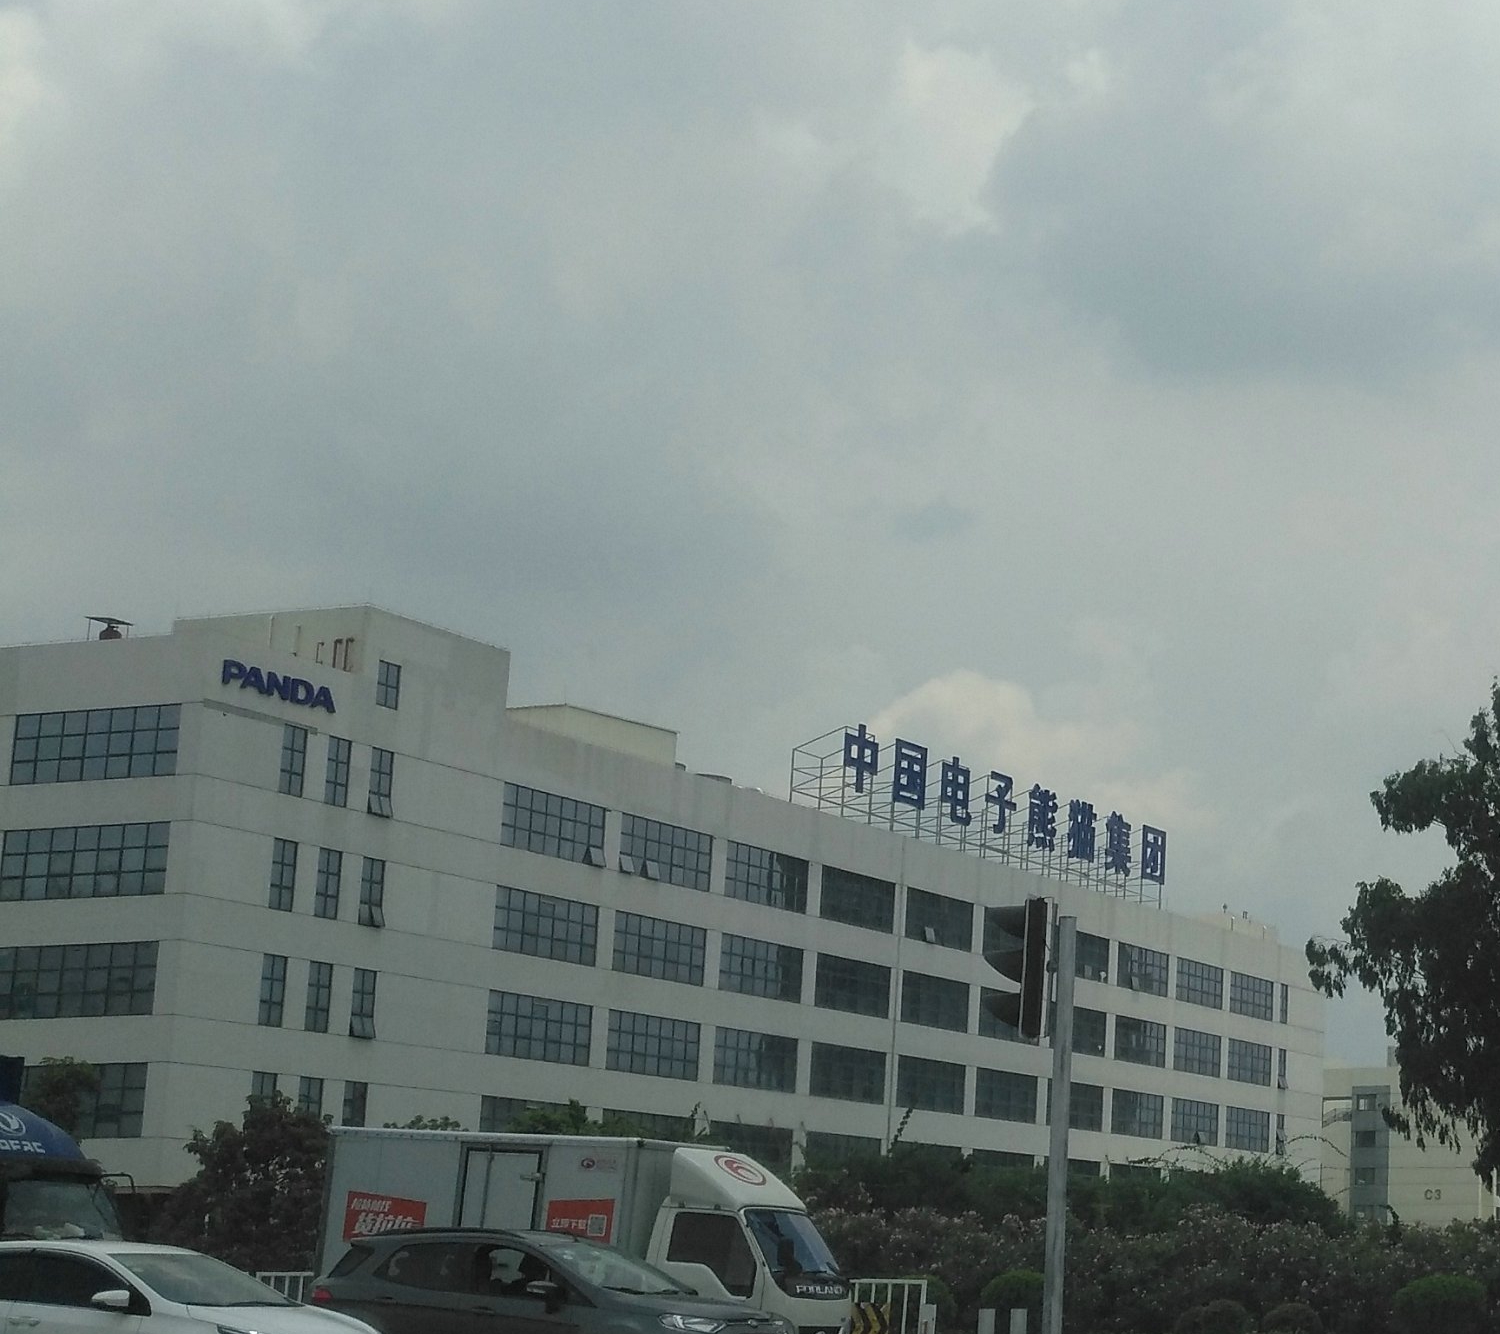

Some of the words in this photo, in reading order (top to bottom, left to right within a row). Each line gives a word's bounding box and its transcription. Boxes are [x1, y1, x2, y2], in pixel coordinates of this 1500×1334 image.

[222, 659, 336, 713] PANDA
[843, 723, 1167, 885] 中国电子熊猫集团
[1424, 1188, 1441, 1200] C3
